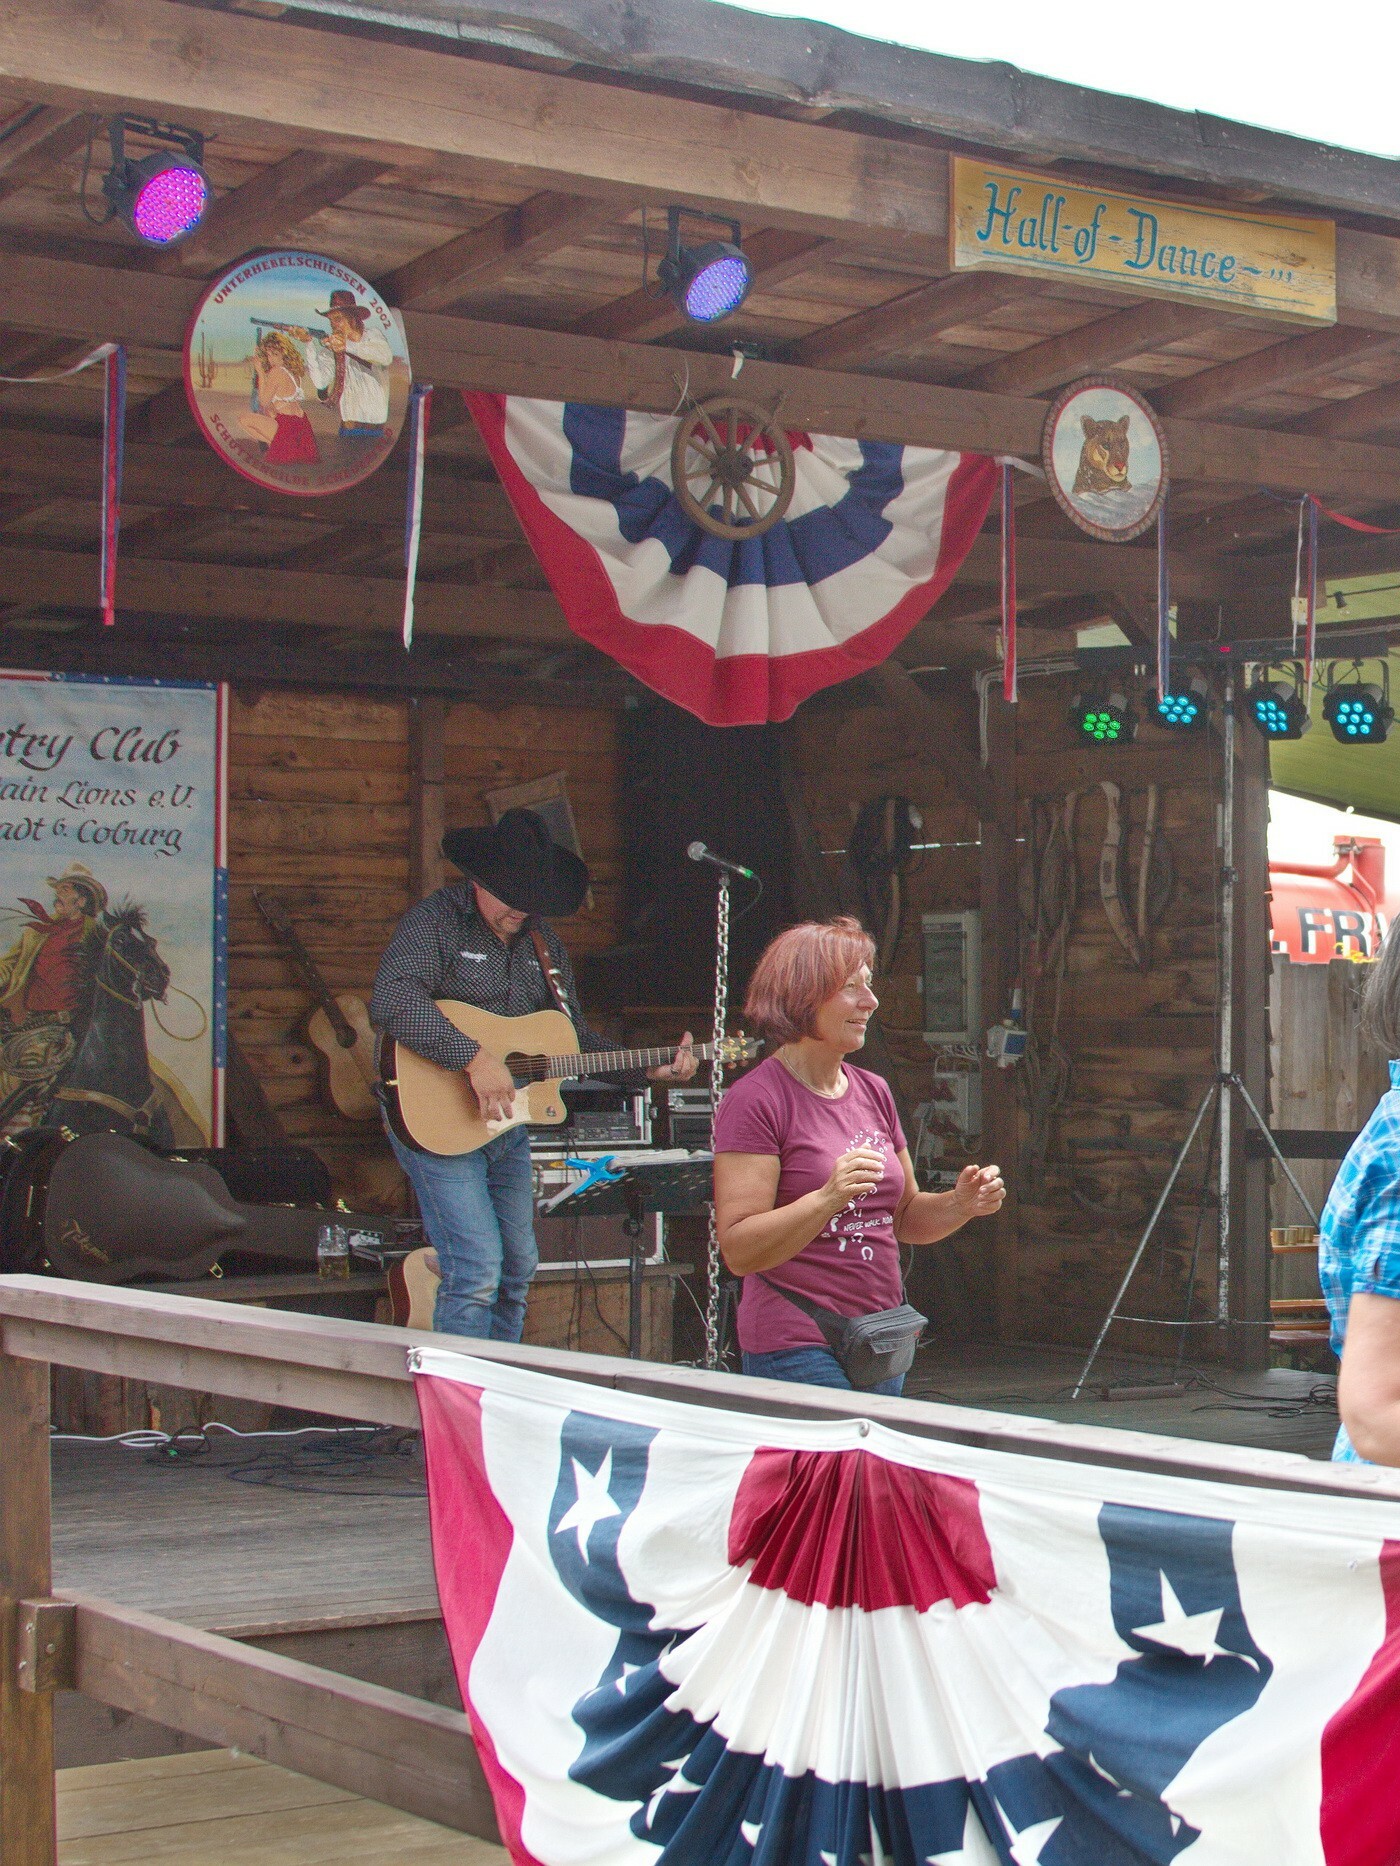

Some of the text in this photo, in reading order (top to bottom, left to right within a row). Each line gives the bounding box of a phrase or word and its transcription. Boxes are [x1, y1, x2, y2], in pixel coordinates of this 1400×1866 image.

[213, 256, 392, 330] UNTERHEBELSCHIESSEN 2002
[0, 723, 182, 771] try Club
[56, 780, 137, 812] Lions
[77, 819, 183, 857] Coburg
